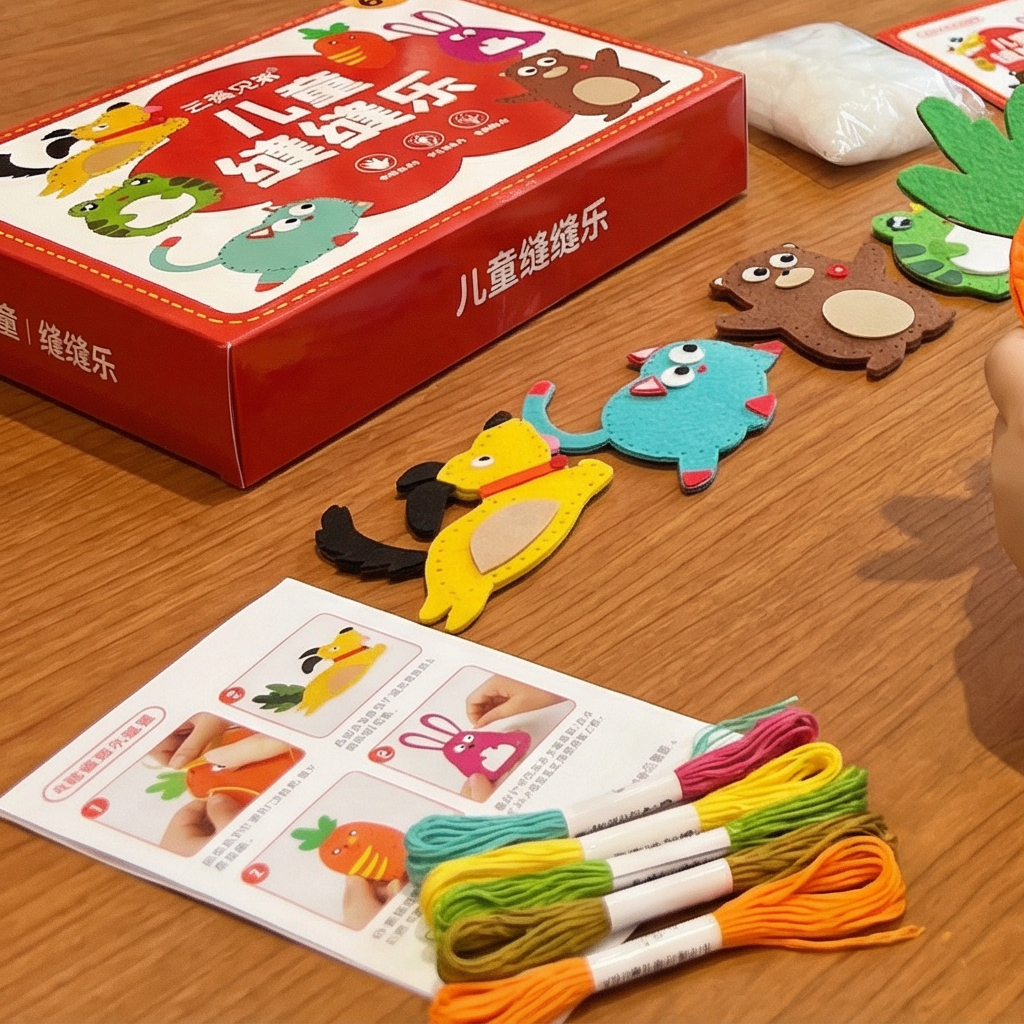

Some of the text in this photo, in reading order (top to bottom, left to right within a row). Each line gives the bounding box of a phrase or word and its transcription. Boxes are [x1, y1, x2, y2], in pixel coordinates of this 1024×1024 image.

[213, 70, 375, 139] 儿童
[214, 69, 477, 189] 缝缝乐
[456, 196, 609, 318] 儿童缝缝乐
[38, 319, 118, 384] 缝缝乐
